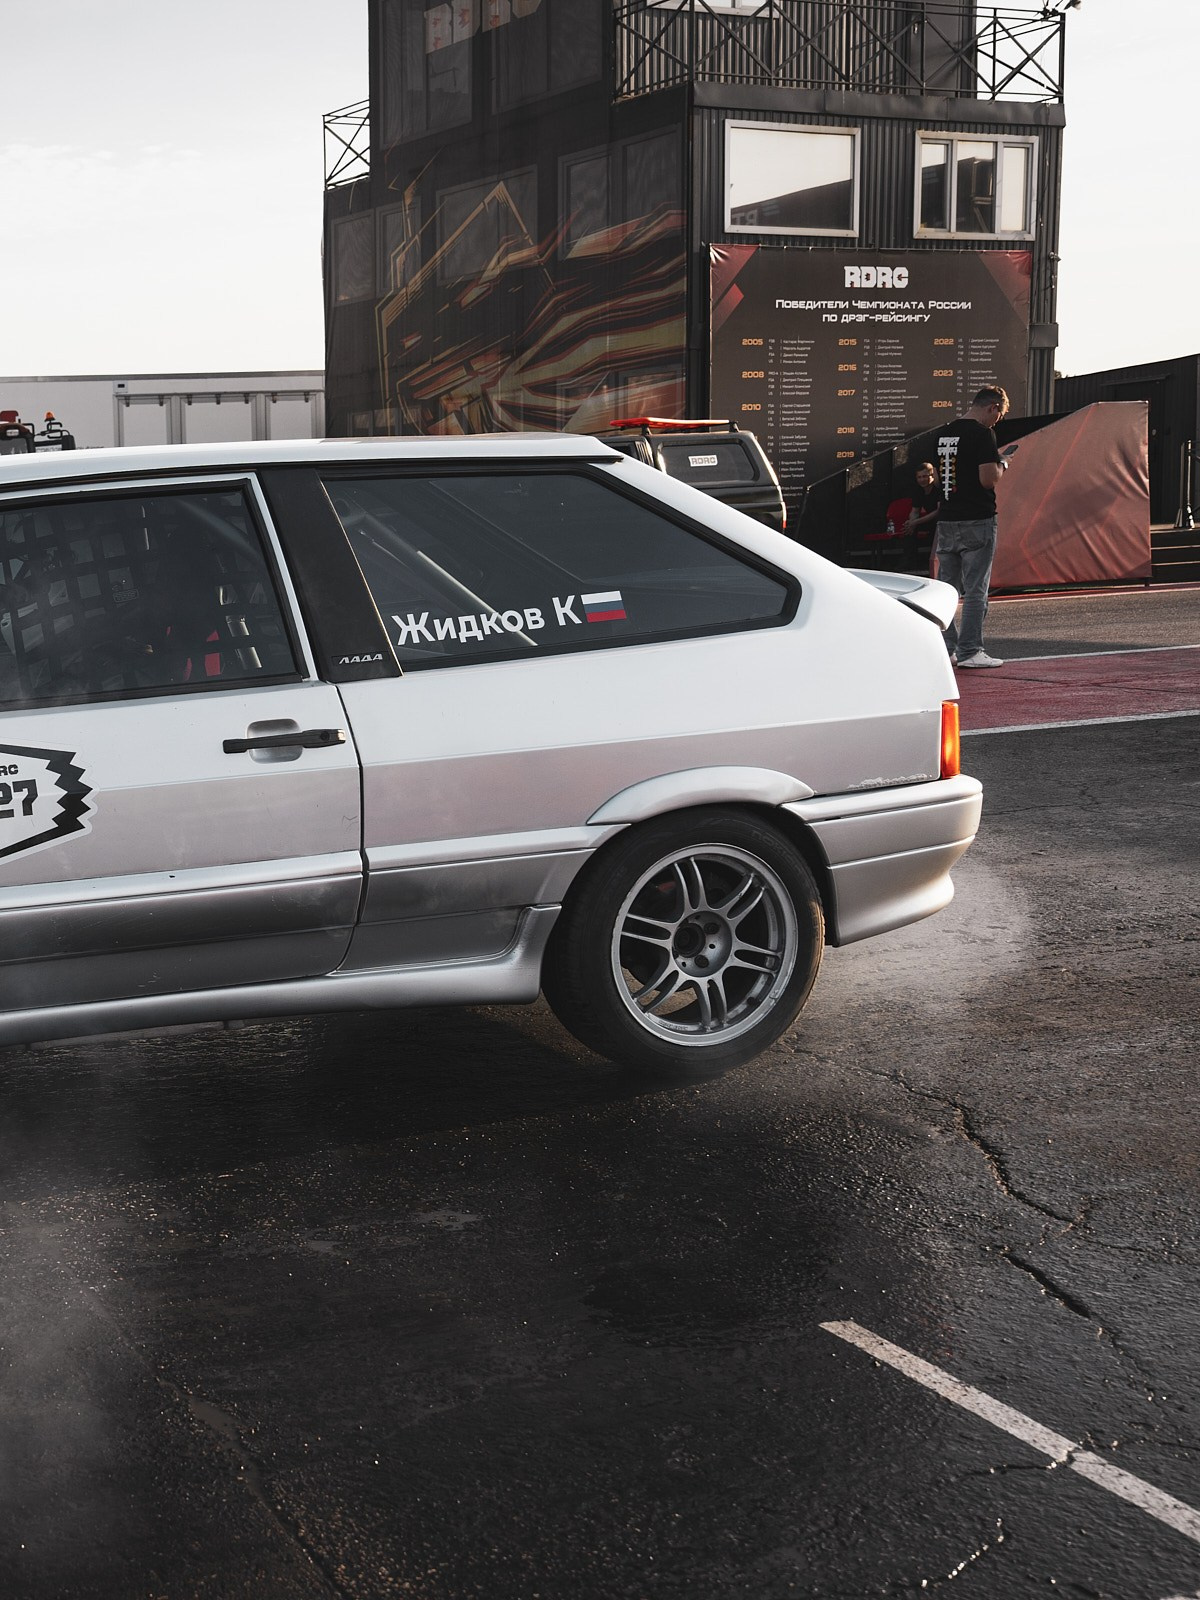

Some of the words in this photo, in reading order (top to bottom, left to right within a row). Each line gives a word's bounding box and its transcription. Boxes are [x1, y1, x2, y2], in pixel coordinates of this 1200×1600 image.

[844, 266, 909, 288] RDRC
[391, 607, 545, 646] Жидков
[552, 595, 583, 626] К
[339, 653, 383, 665] ЛАДА
